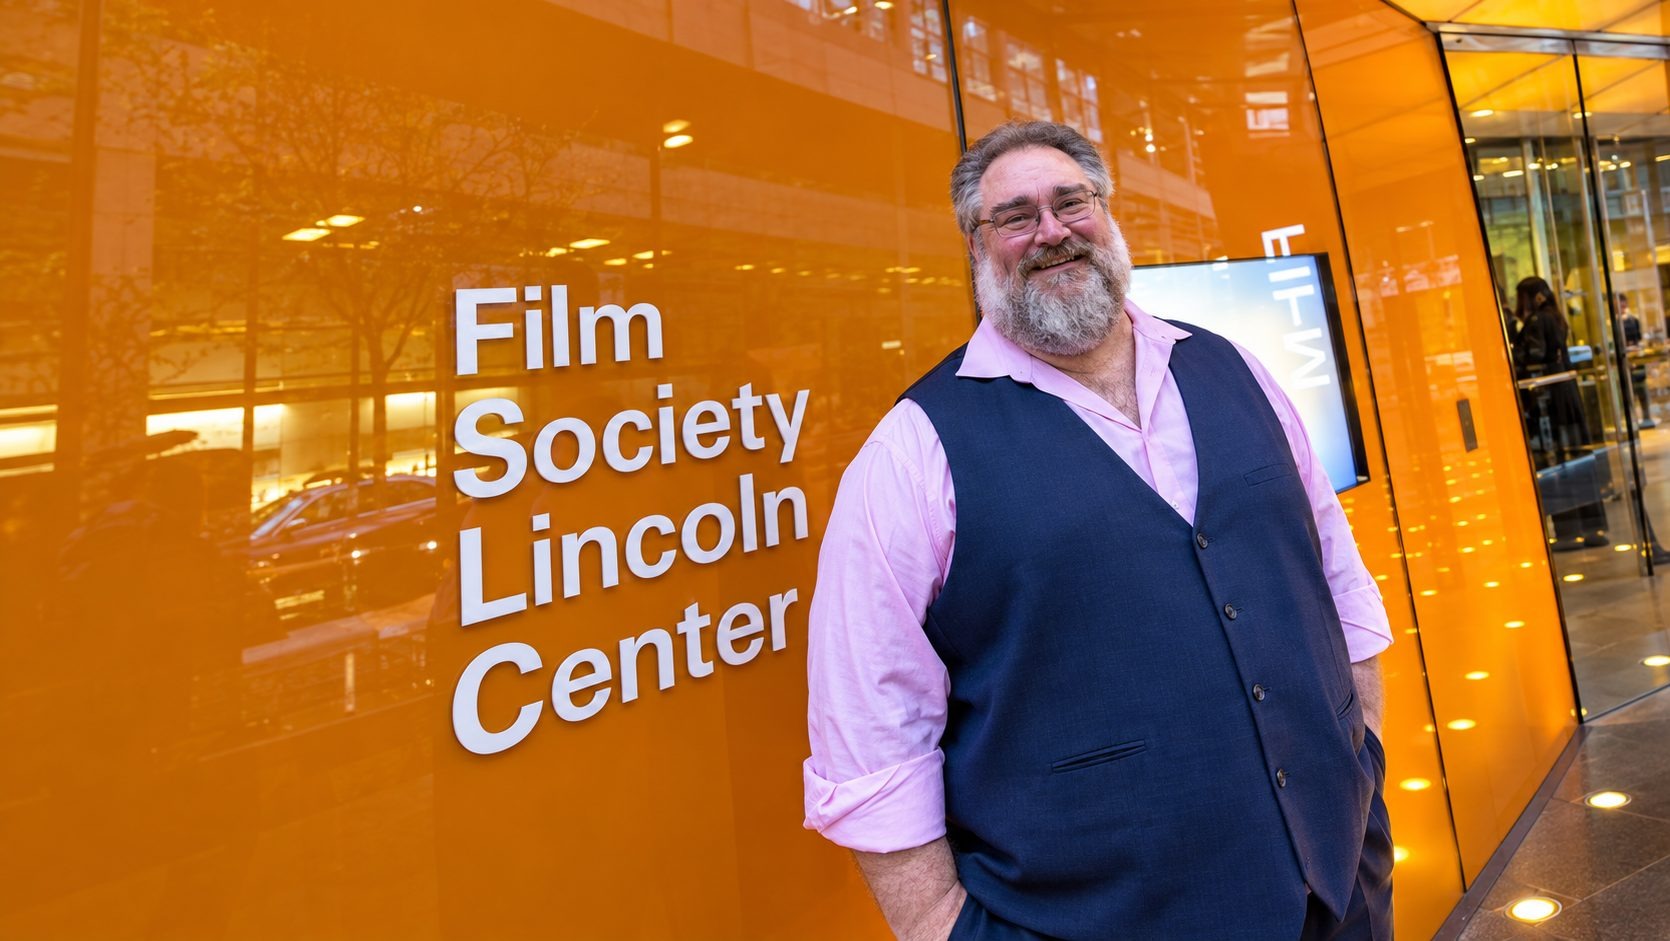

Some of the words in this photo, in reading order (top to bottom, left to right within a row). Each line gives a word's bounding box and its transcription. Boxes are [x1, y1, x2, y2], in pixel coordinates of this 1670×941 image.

[455, 284, 664, 376] Film
[453, 383, 810, 499] Society
[459, 473, 809, 627] Lincoln
[452, 588, 798, 755] Center
